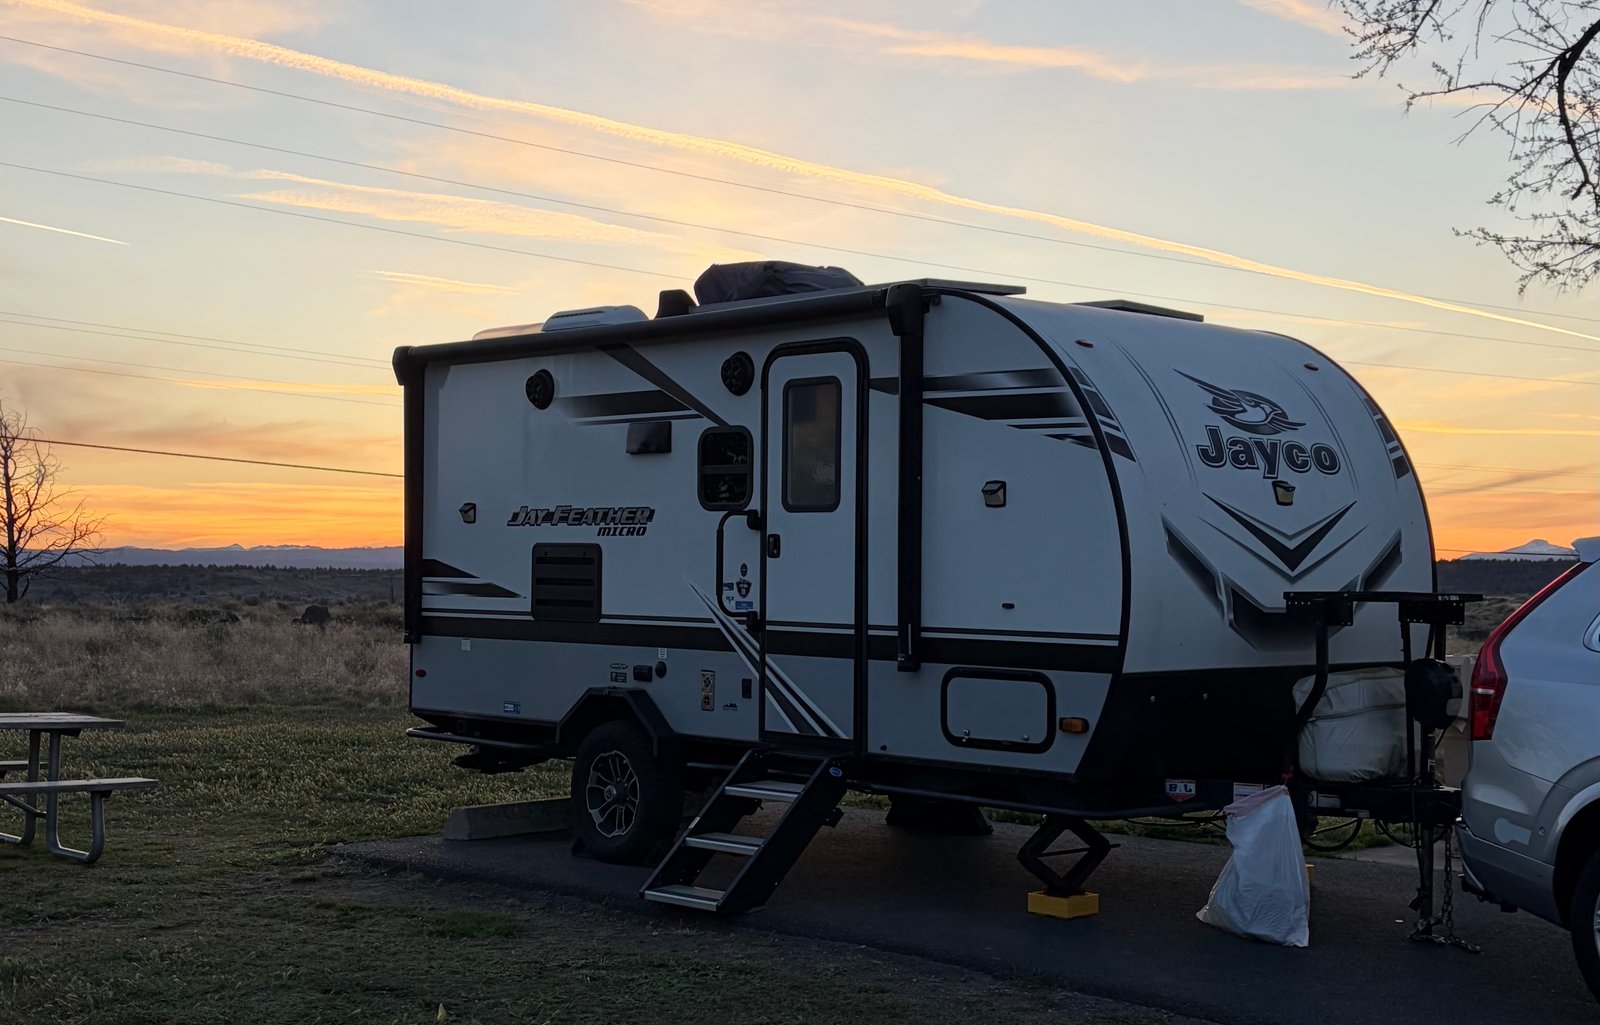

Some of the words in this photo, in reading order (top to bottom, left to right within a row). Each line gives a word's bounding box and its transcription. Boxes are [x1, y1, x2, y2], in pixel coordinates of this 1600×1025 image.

[1196, 425, 1340, 479] Jayco
[507, 506, 549, 527] JAY
[551, 505, 654, 527] FEATHER
[597, 526, 647, 537] MICRO
